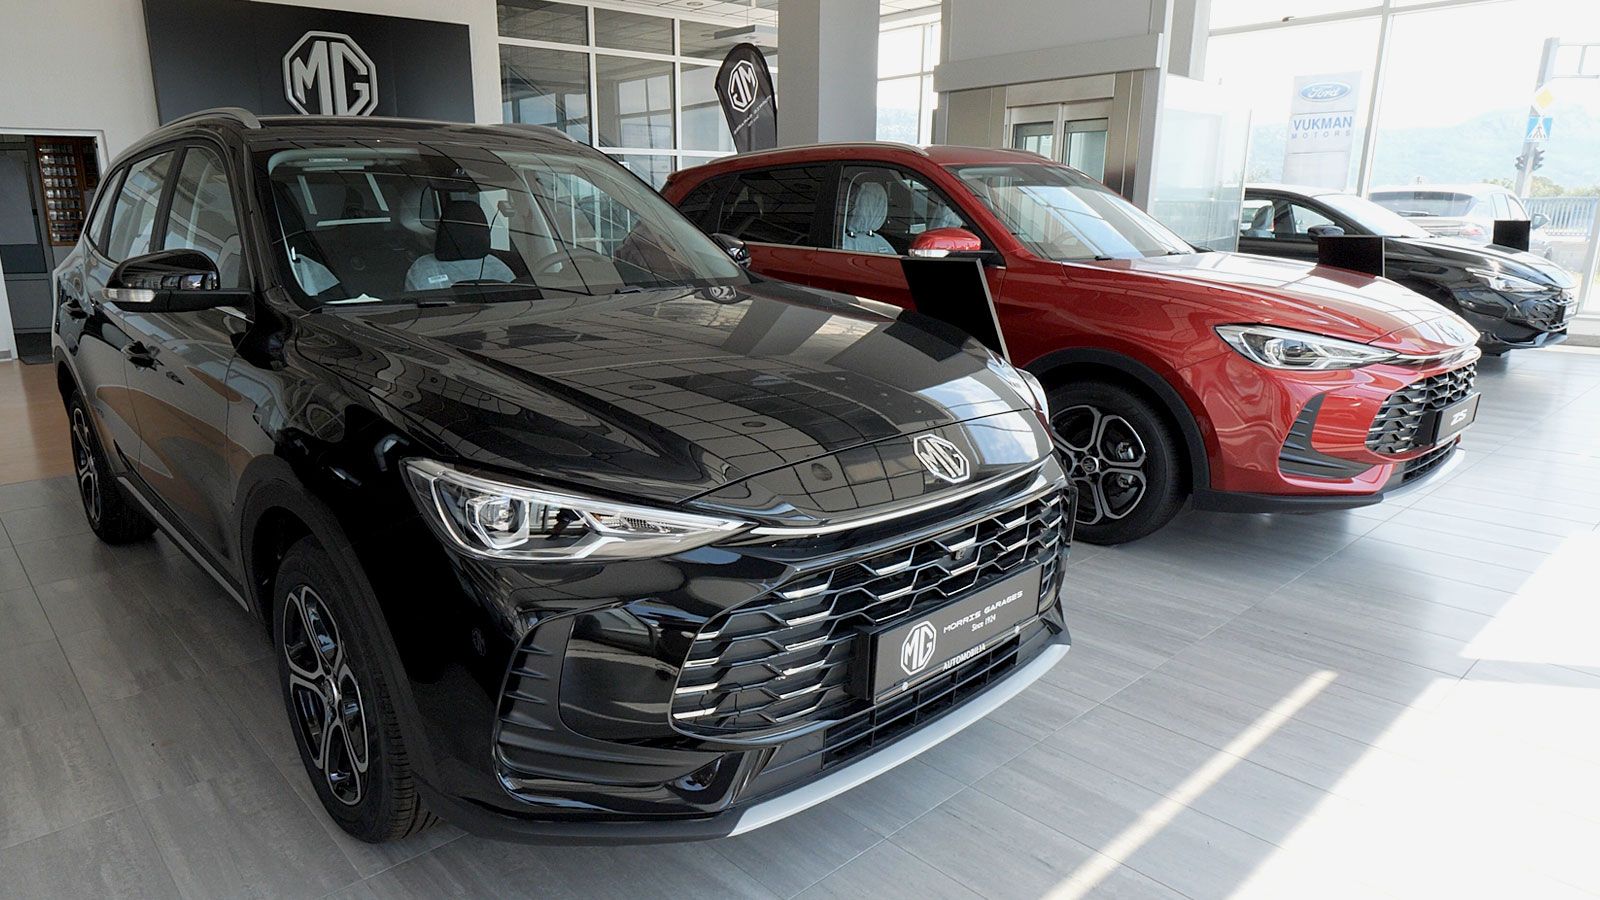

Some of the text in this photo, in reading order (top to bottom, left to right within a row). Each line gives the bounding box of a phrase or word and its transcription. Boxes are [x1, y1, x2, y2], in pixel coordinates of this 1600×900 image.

[290, 39, 370, 116] MG
[1291, 130, 1351, 139] MOTORS
[1293, 116, 1352, 131] VUKMAN
[918, 437, 966, 479] MG
[943, 590, 1024, 634] MORRIS GARAGES
[971, 620, 984, 632] Since
[902, 624, 934, 672] MG
